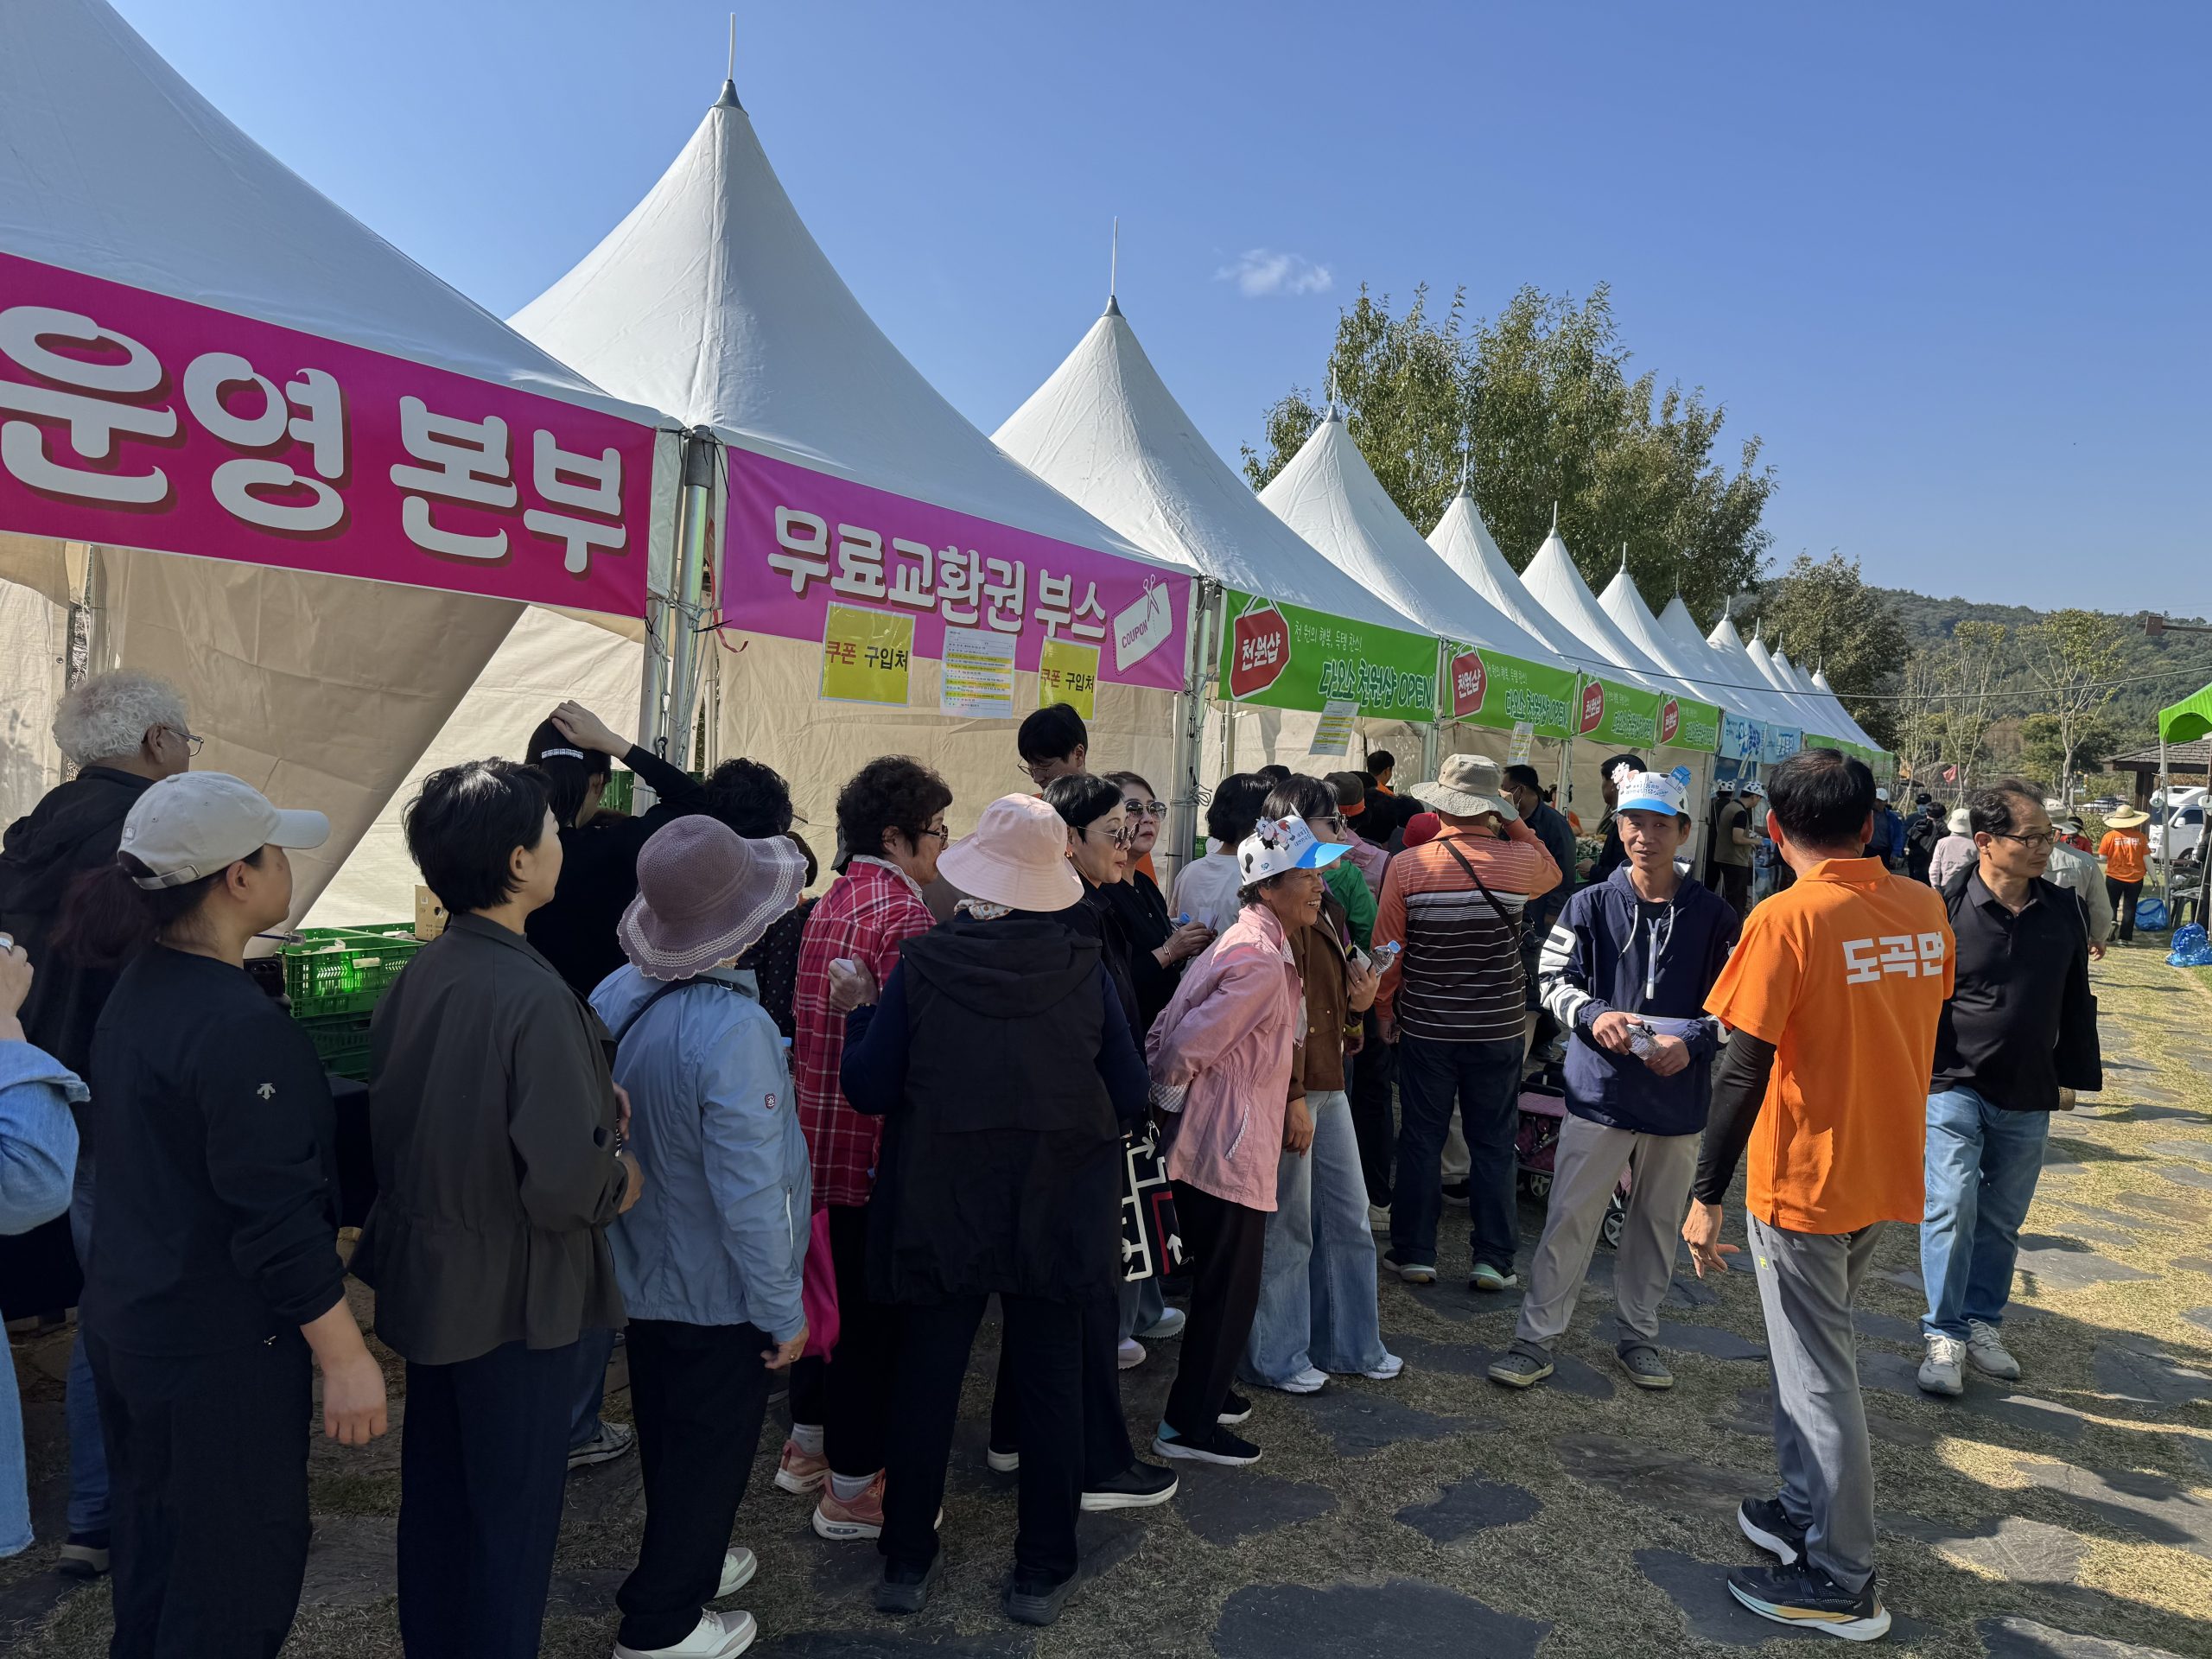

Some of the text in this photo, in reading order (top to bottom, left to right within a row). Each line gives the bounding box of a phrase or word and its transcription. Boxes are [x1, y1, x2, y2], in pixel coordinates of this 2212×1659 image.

[0, 305, 626, 573] 운영 본부
[767, 505, 1106, 638] 무료교환권 부스
[1122, 620, 1148, 649] COUPON
[1242, 631, 1281, 671] 천원샵
[825, 640, 909, 672] 쿠폰 구입처
[1040, 668, 1095, 694] 쿠폰 구입처
[1357, 657, 1398, 709] 천원샵
[1458, 667, 1482, 699] 천원샵
[1585, 695, 1601, 720] 천원샵
[1842, 931, 1945, 985] 도곡면
